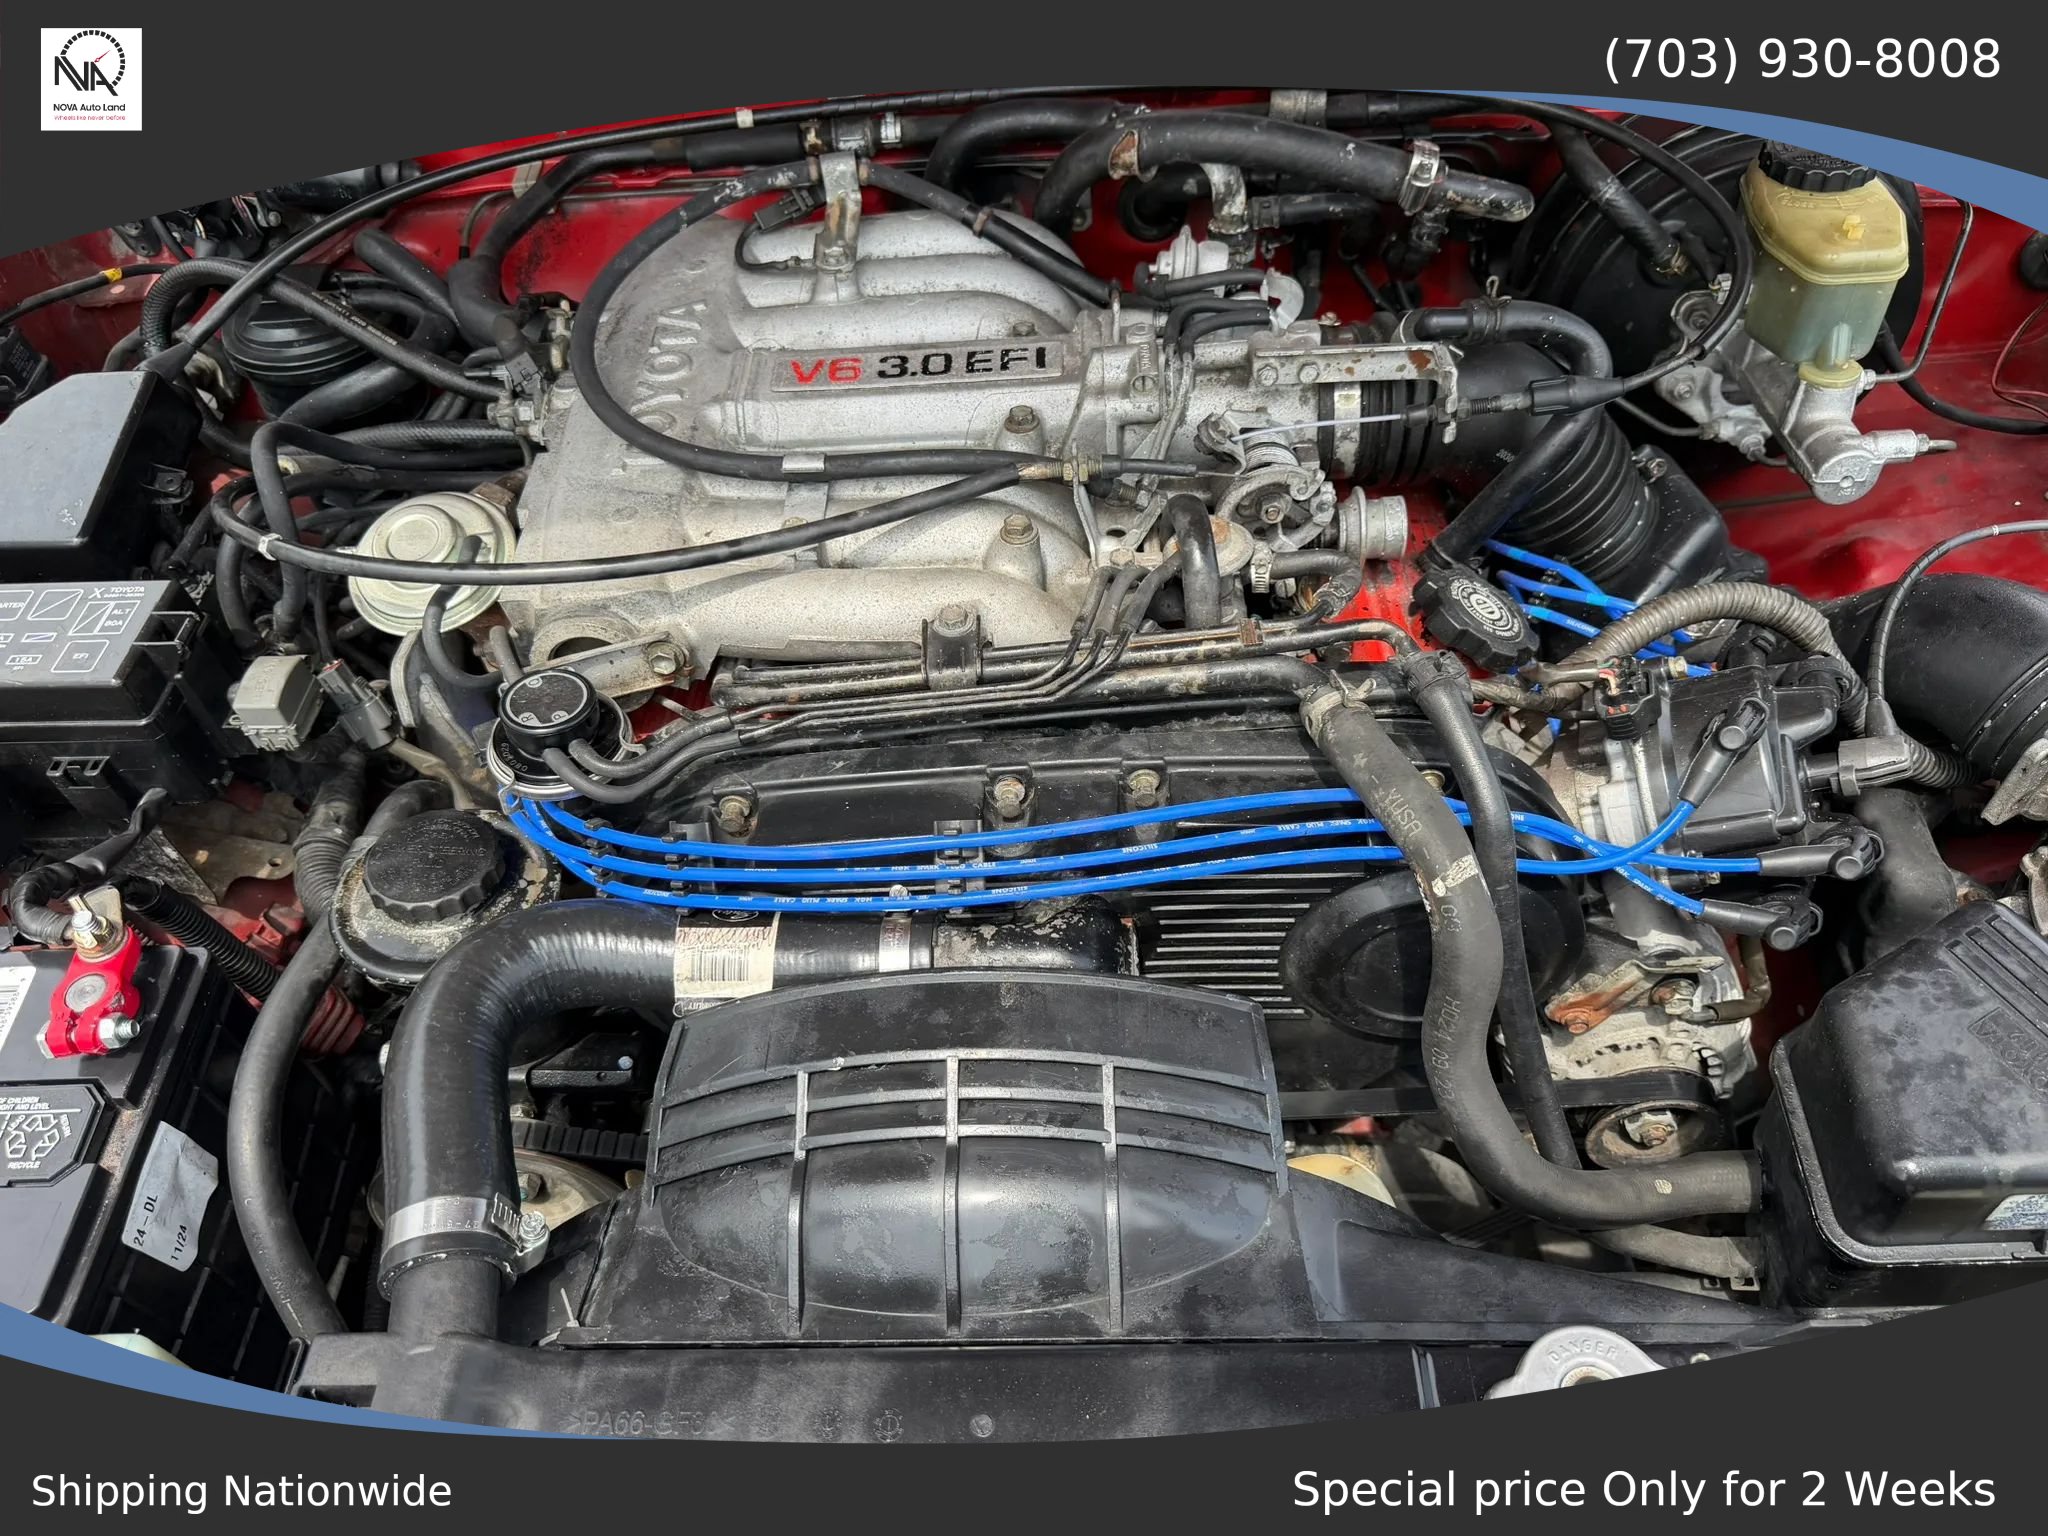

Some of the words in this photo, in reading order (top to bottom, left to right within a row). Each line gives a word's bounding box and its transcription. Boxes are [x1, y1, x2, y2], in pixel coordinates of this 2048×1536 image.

[790, 357, 864, 385] V6
[877, 355, 952, 378] 3.0
[965, 347, 1047, 374] EFI
[1384, 787, 1424, 838] YUSA
[1122, 843, 1159, 854] SILICONE
[991, 886, 1029, 895] SILICONE
[8, 1096, 41, 1104] CHILDREN
[30, 1102, 51, 1110] LEVEL
[7, 1160, 42, 1170] RECYCLE
[170, 1223, 189, 1262] 11/24
[1547, 1339, 1620, 1364] DANGER
